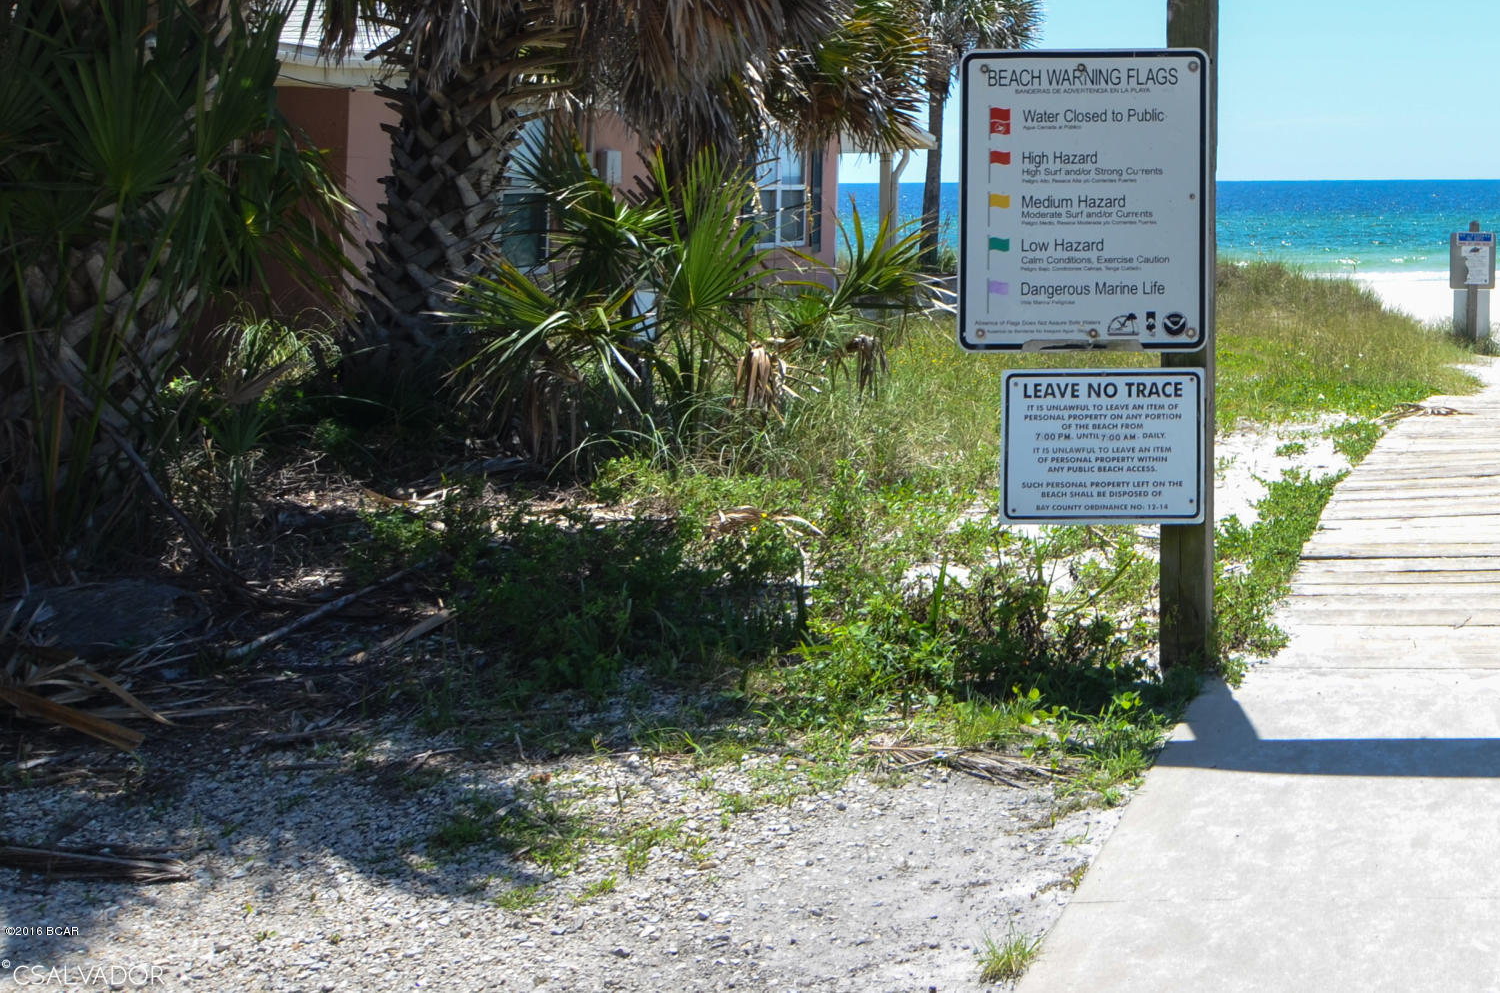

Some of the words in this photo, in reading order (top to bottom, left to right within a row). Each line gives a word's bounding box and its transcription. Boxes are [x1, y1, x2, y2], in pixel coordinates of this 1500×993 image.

[988, 69, 1041, 86] BEACH
[1046, 68, 1121, 86] WARNING
[1127, 67, 1178, 85] FLAGS
[1022, 109, 1059, 123] Water
[1063, 108, 1107, 123] Closed
[1112, 109, 1123, 122] to
[1127, 108, 1164, 122] Public
[1022, 151, 1049, 168] High
[1053, 150, 1098, 165] Hazard
[1022, 168, 1042, 178] High
[1044, 167, 1062, 176] Surf
[1064, 167, 1092, 176] and/or
[1094, 167, 1123, 177] Strong
[1021, 194, 1073, 209] Medium
[1078, 194, 1126, 209] Hazard
[1021, 210, 1062, 219] Moderate
[1065, 210, 1084, 219] Surf
[1086, 210, 1113, 218] and/or
[1115, 209, 1153, 218] Currents
[1021, 238, 1050, 252] Low
[1054, 238, 1104, 252] Hazard
[1021, 256, 1044, 264] Calm
[1046, 255, 1094, 265] Conditions,
[1096, 255, 1134, 264] Exercise
[1136, 254, 1170, 264] Caution
[1020, 281, 1091, 299] Dangerous
[1095, 281, 1138, 296] Marine
[1142, 280, 1166, 295] Life
[1023, 382, 1080, 399] LEAVE
[1087, 382, 1118, 398] NO
[1125, 381, 1183, 398] TRACE
[1026, 404, 1034, 412] IT
[1036, 404, 1044, 412] IS
[1046, 404, 1090, 412] UNLAWFUL
[1106, 403, 1129, 411] LEAVE
[1131, 403, 1144, 411] AN
[1067, 413, 1108, 421] PROPERTY
[1110, 413, 1123, 421] ON
[1111, 446, 1136, 454] LEAVE
[1097, 465, 1124, 473] BEACH
[1021, 481, 1044, 489] SUCH
